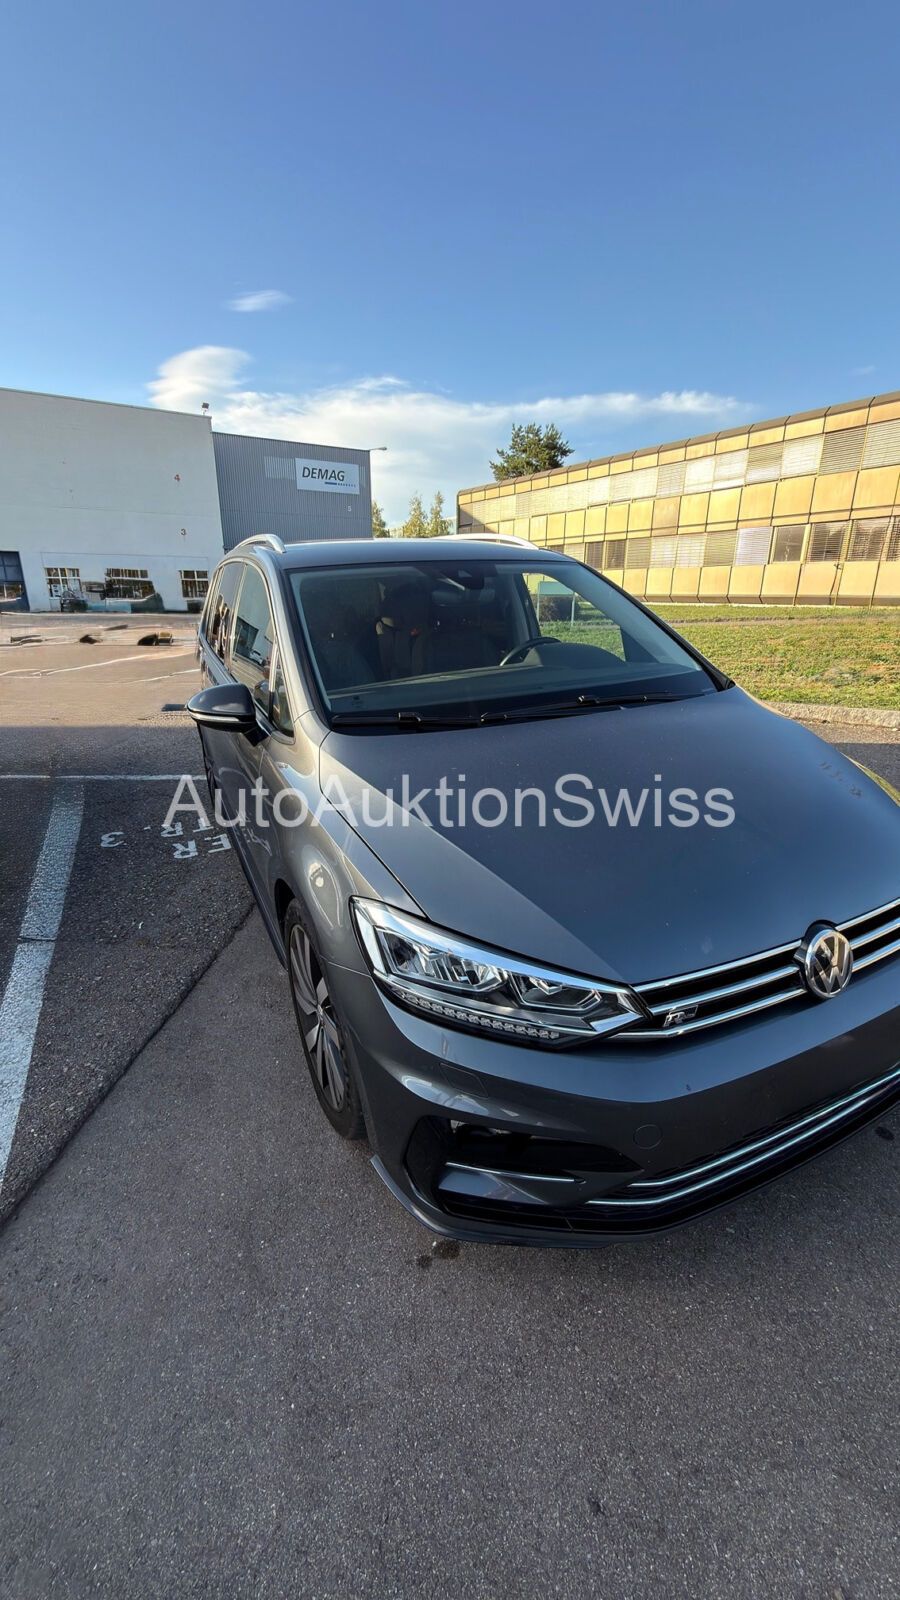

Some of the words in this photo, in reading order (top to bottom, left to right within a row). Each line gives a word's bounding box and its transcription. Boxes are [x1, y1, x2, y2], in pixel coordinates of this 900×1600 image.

[302, 467, 345, 482] DEMAG
[180, 528, 187, 536] 3
[100, 831, 127, 848] 3
[808, 931, 852, 997] VW
